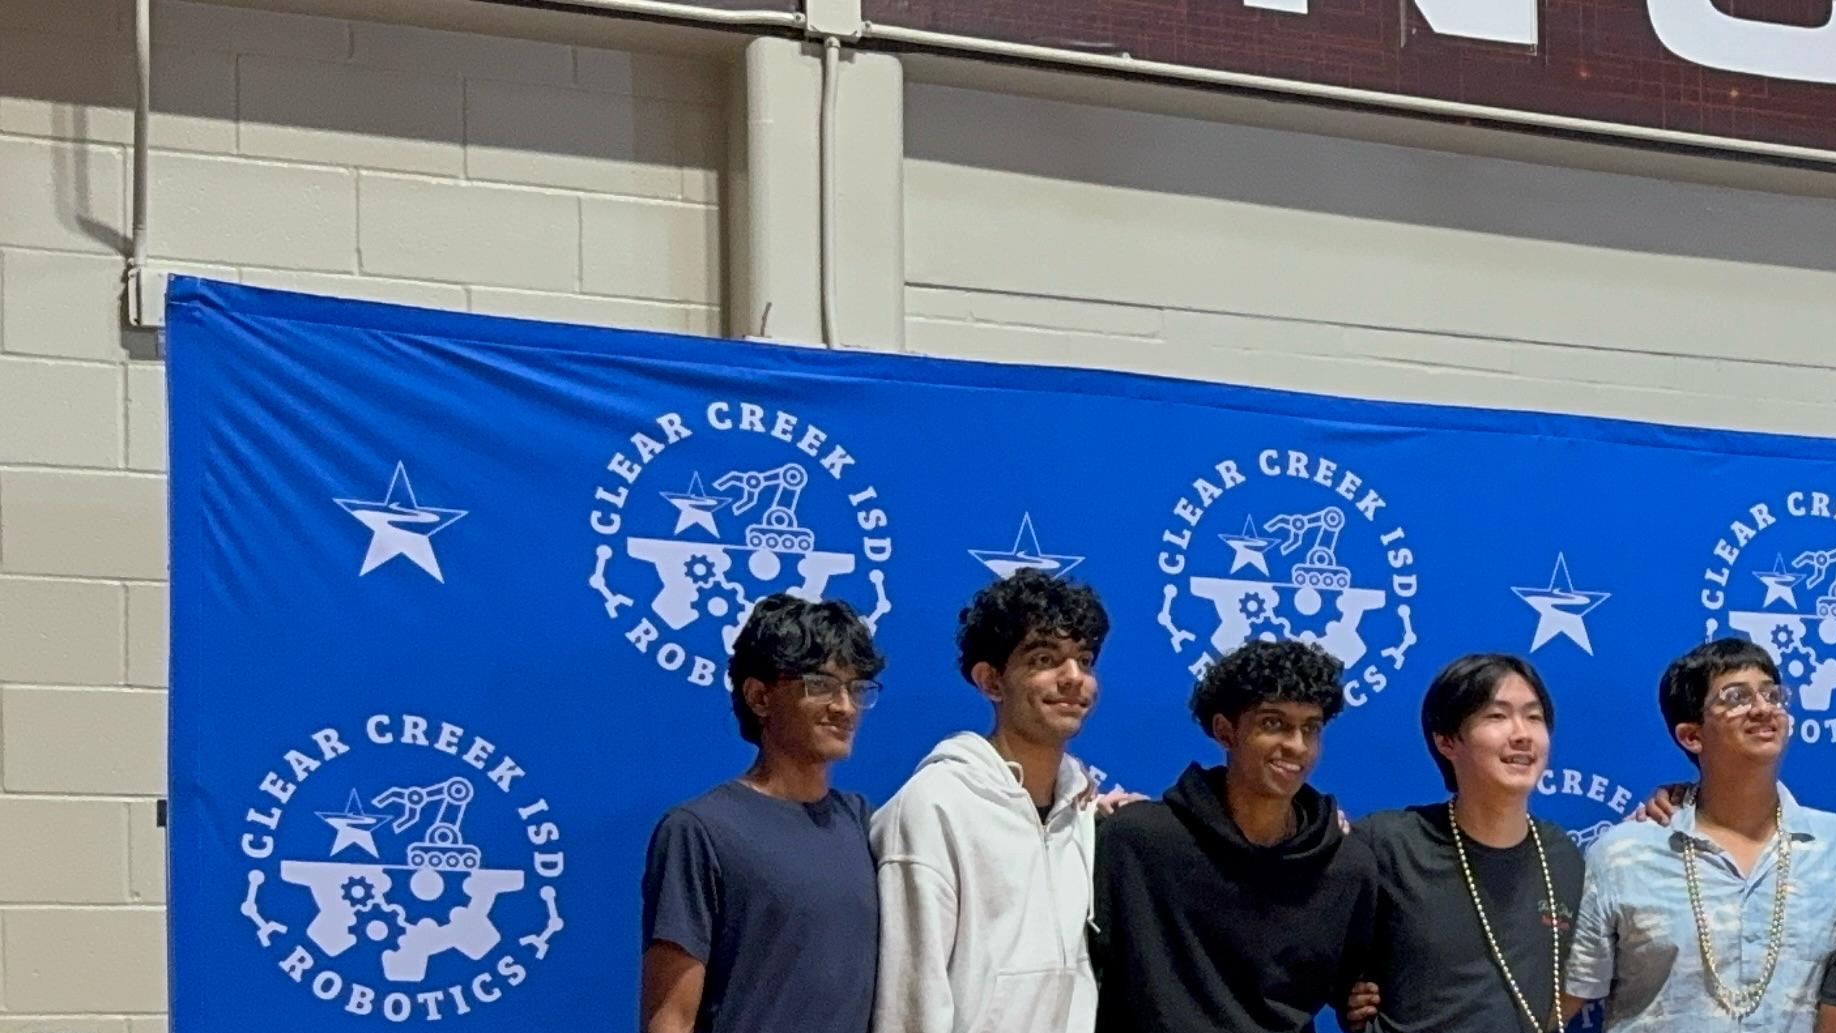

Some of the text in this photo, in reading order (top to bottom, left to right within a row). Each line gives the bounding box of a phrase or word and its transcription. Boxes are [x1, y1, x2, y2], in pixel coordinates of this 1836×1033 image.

[590, 401, 892, 562] CLEAR CREEK ISD
[1158, 449, 1418, 597] CLEAR CREEK ISD
[1701, 503, 1776, 610] CLEAR
[240, 713, 564, 878] CLEAR CREEK ISD
[1536, 768, 1646, 814] CREE
[279, 955, 526, 1023] ROBOTICS
